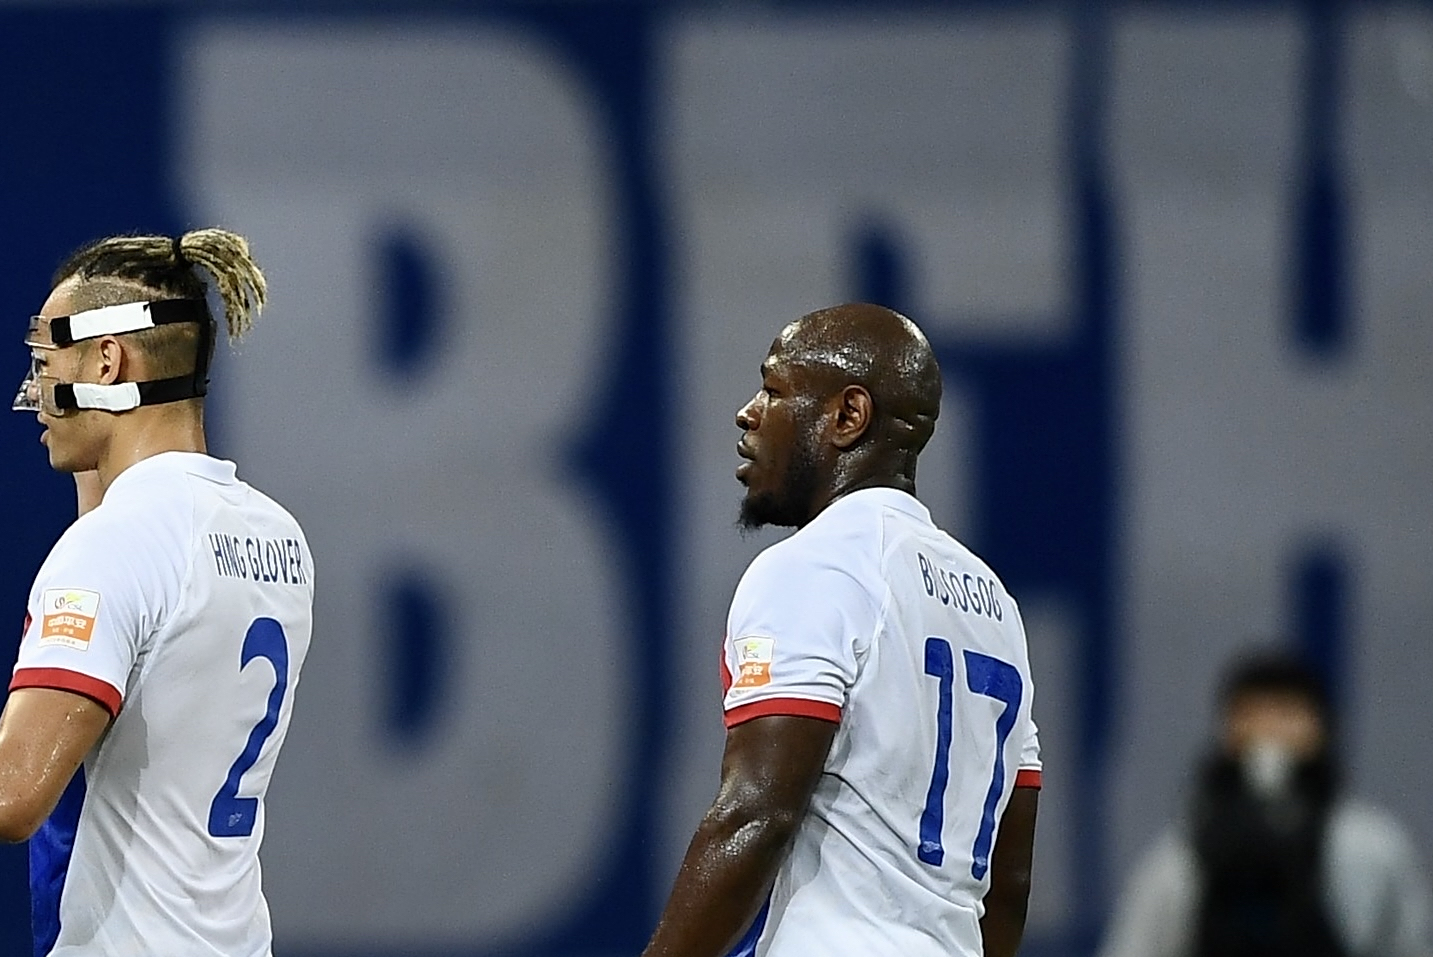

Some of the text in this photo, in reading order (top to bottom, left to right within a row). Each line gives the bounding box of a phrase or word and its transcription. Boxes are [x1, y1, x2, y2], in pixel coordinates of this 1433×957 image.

[245, 537, 307, 585] GLOVER
[207, 616, 289, 837] 2
[917, 637, 1023, 881] 17
